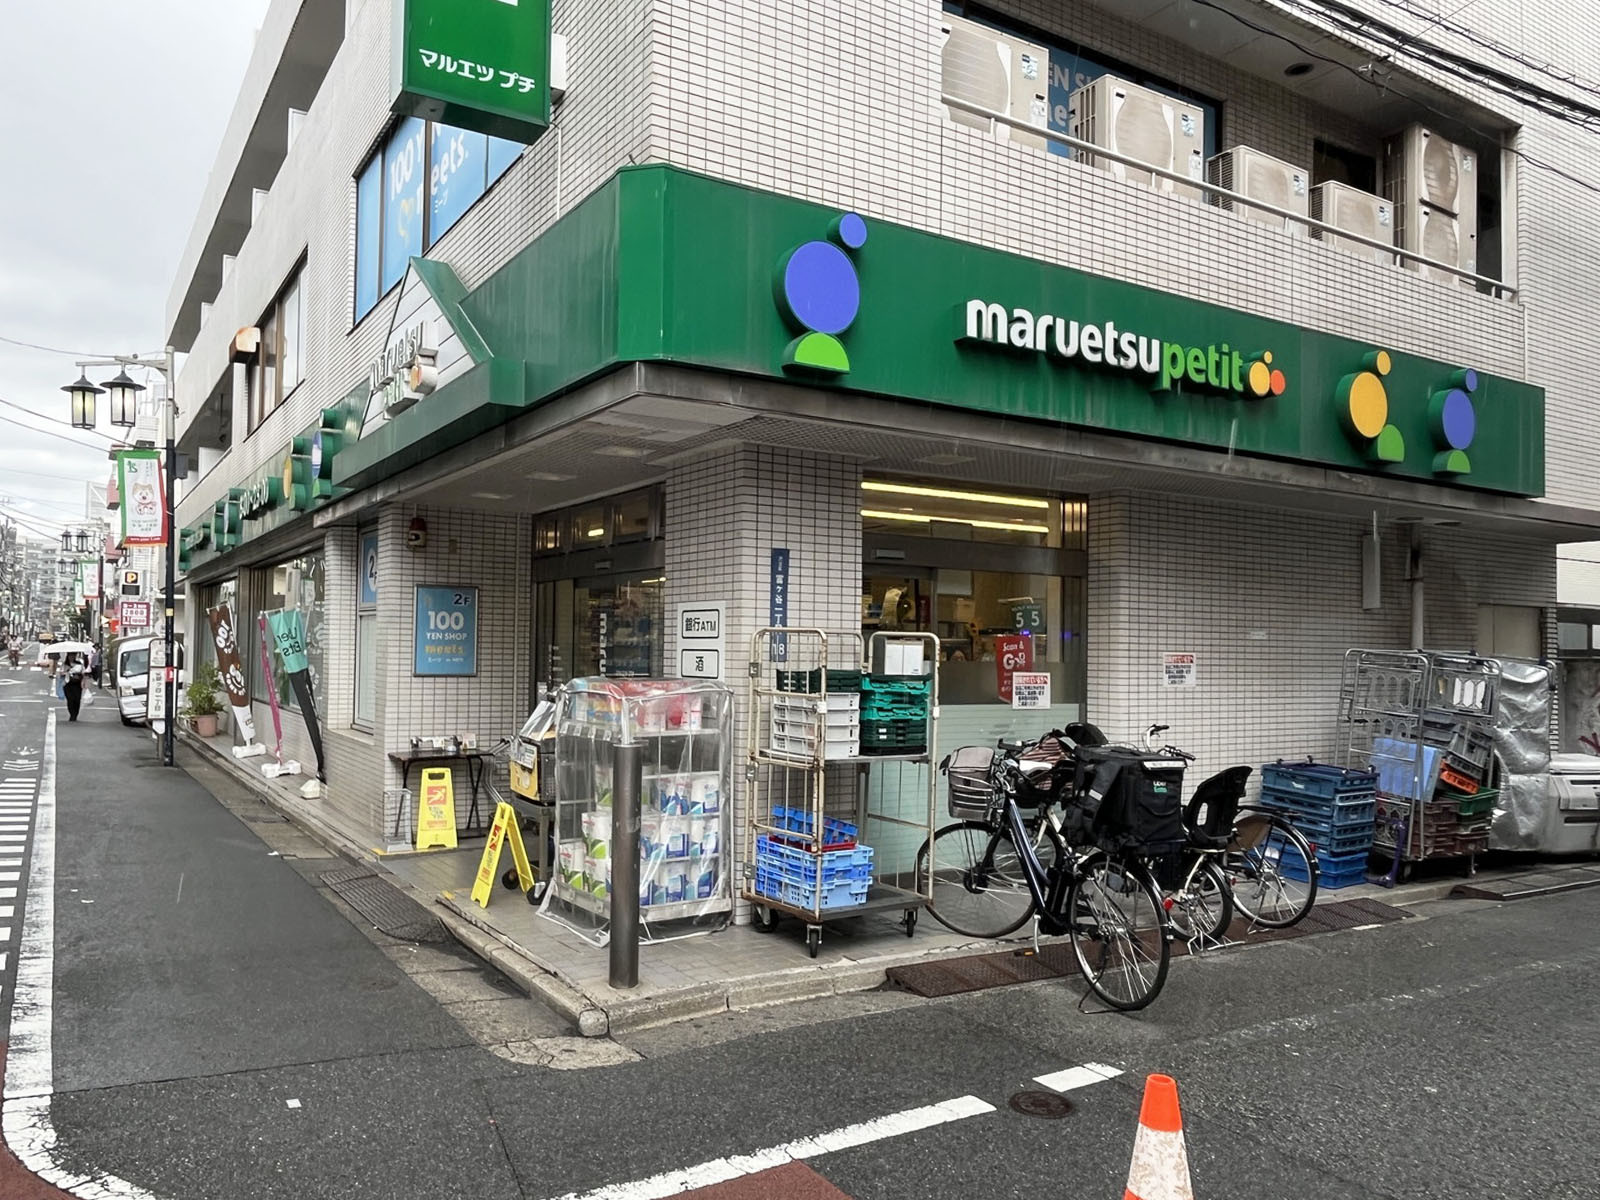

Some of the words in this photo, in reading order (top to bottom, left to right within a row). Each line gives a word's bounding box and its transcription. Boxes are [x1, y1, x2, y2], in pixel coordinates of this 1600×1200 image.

[418, 48, 495, 82] マルエツ
[498, 70, 536, 93] プチ
[453, 593, 471, 606] 2F
[427, 610, 465, 631] 100
[426, 632, 443, 641] YEN
[444, 632, 468, 641] SHOP
